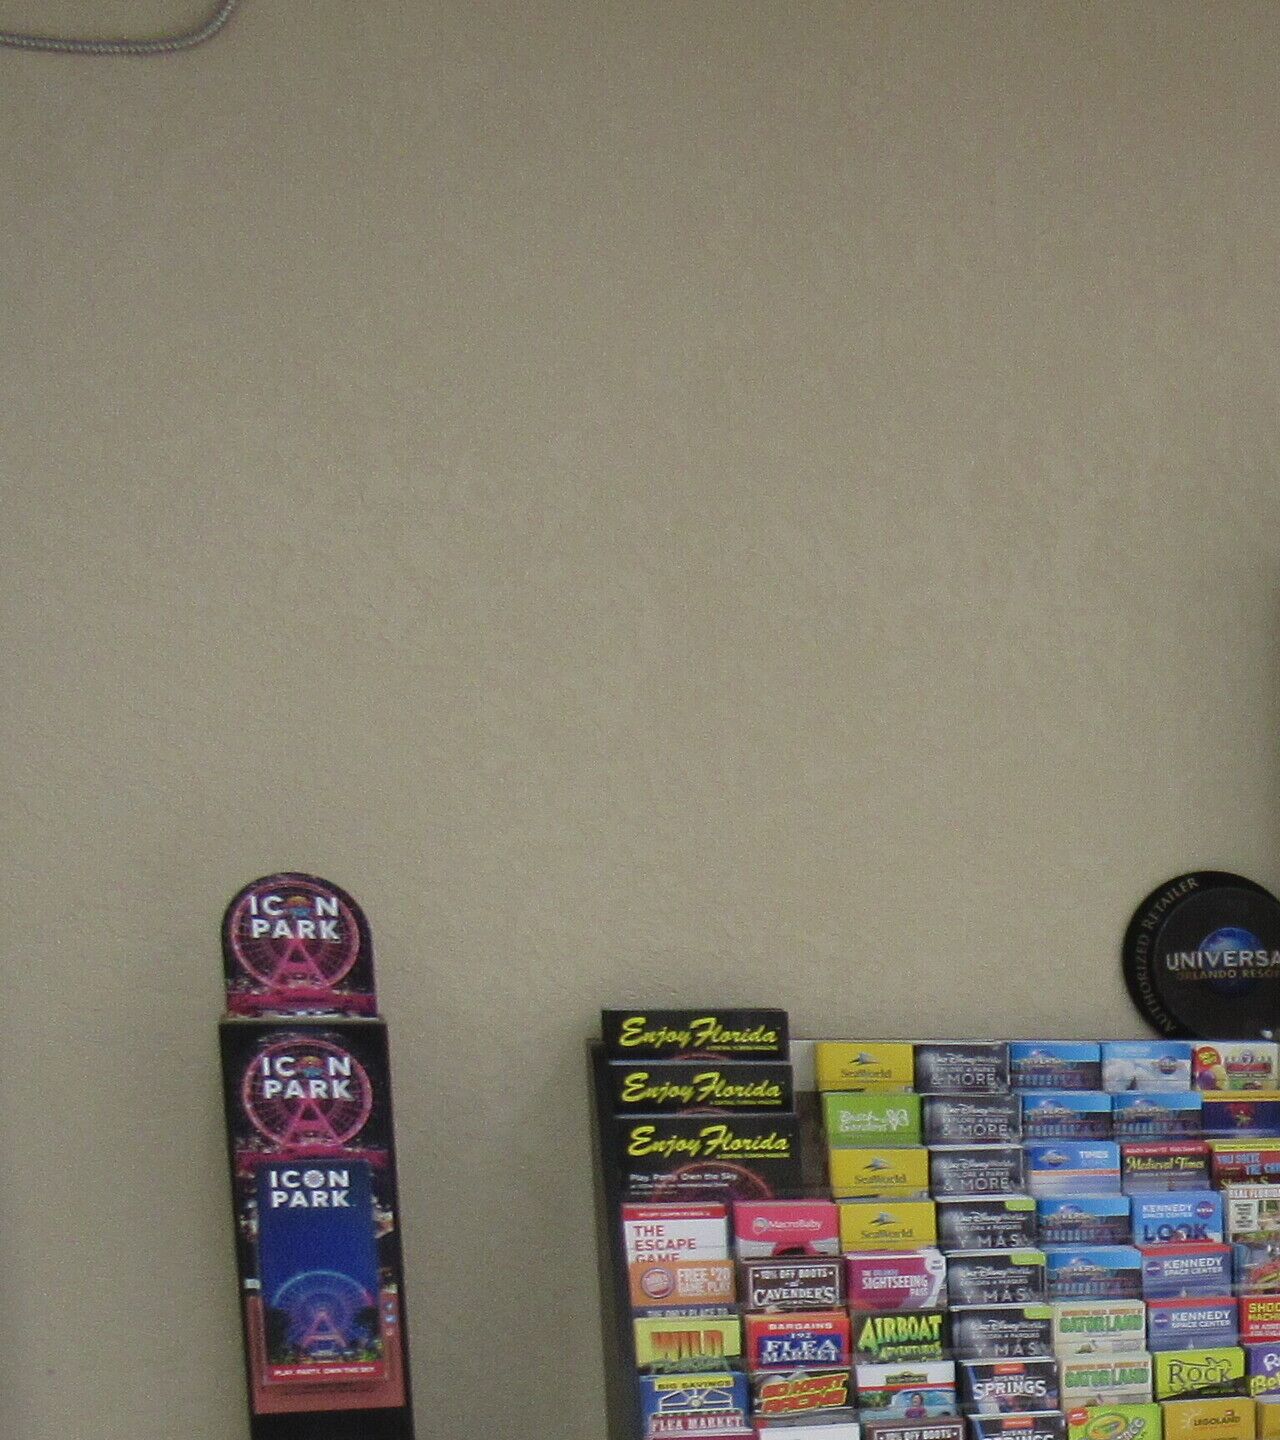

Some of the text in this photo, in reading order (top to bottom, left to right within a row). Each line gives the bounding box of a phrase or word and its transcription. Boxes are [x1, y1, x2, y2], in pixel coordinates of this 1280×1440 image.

[1141, 877, 1200, 931] RETAILER
[251, 918, 341, 940] PARK
[619, 1017, 778, 1048] Enjoy Florida
[948, 1073, 996, 1086] MORE
[262, 1077, 355, 1100] PARK
[622, 1072, 782, 1103] Enjoy Florida
[959, 1124, 1009, 1137] MORE
[628, 1125, 790, 1158] Enjoy Florida
[1125, 1156, 1205, 1173] Medieval Times
[268, 1169, 351, 1190] ICON
[961, 1179, 1009, 1191] MORE
[271, 1190, 352, 1209] PARK
[1142, 1202, 1192, 1213] KENNEDY
[633, 1225, 664, 1237] THE
[635, 1238, 696, 1251] ESCAPE
[1163, 1257, 1223, 1269] KENNEDY
[780, 1269, 796, 1278] OFF
[1164, 1265, 1224, 1276] SPACE CENTER
[862, 1275, 928, 1289] SIGHTSEEING
[753, 1286, 836, 1306] CAVENDER'S
[1171, 1310, 1230, 1321] KENNEDY
[768, 1322, 833, 1330] BARGAINS
[1172, 1319, 1231, 1328] SPACE CENTER
[858, 1315, 942, 1355] AIRBOAT
[766, 1338, 837, 1352] FLEA
[762, 1350, 838, 1364] MARKET
[681, 1379, 732, 1389] SAVINGS
[973, 1380, 1047, 1400] SPRINGS
[651, 1415, 743, 1432] FLEA MARKET
[1194, 1416, 1241, 1427] LEGOLAND
